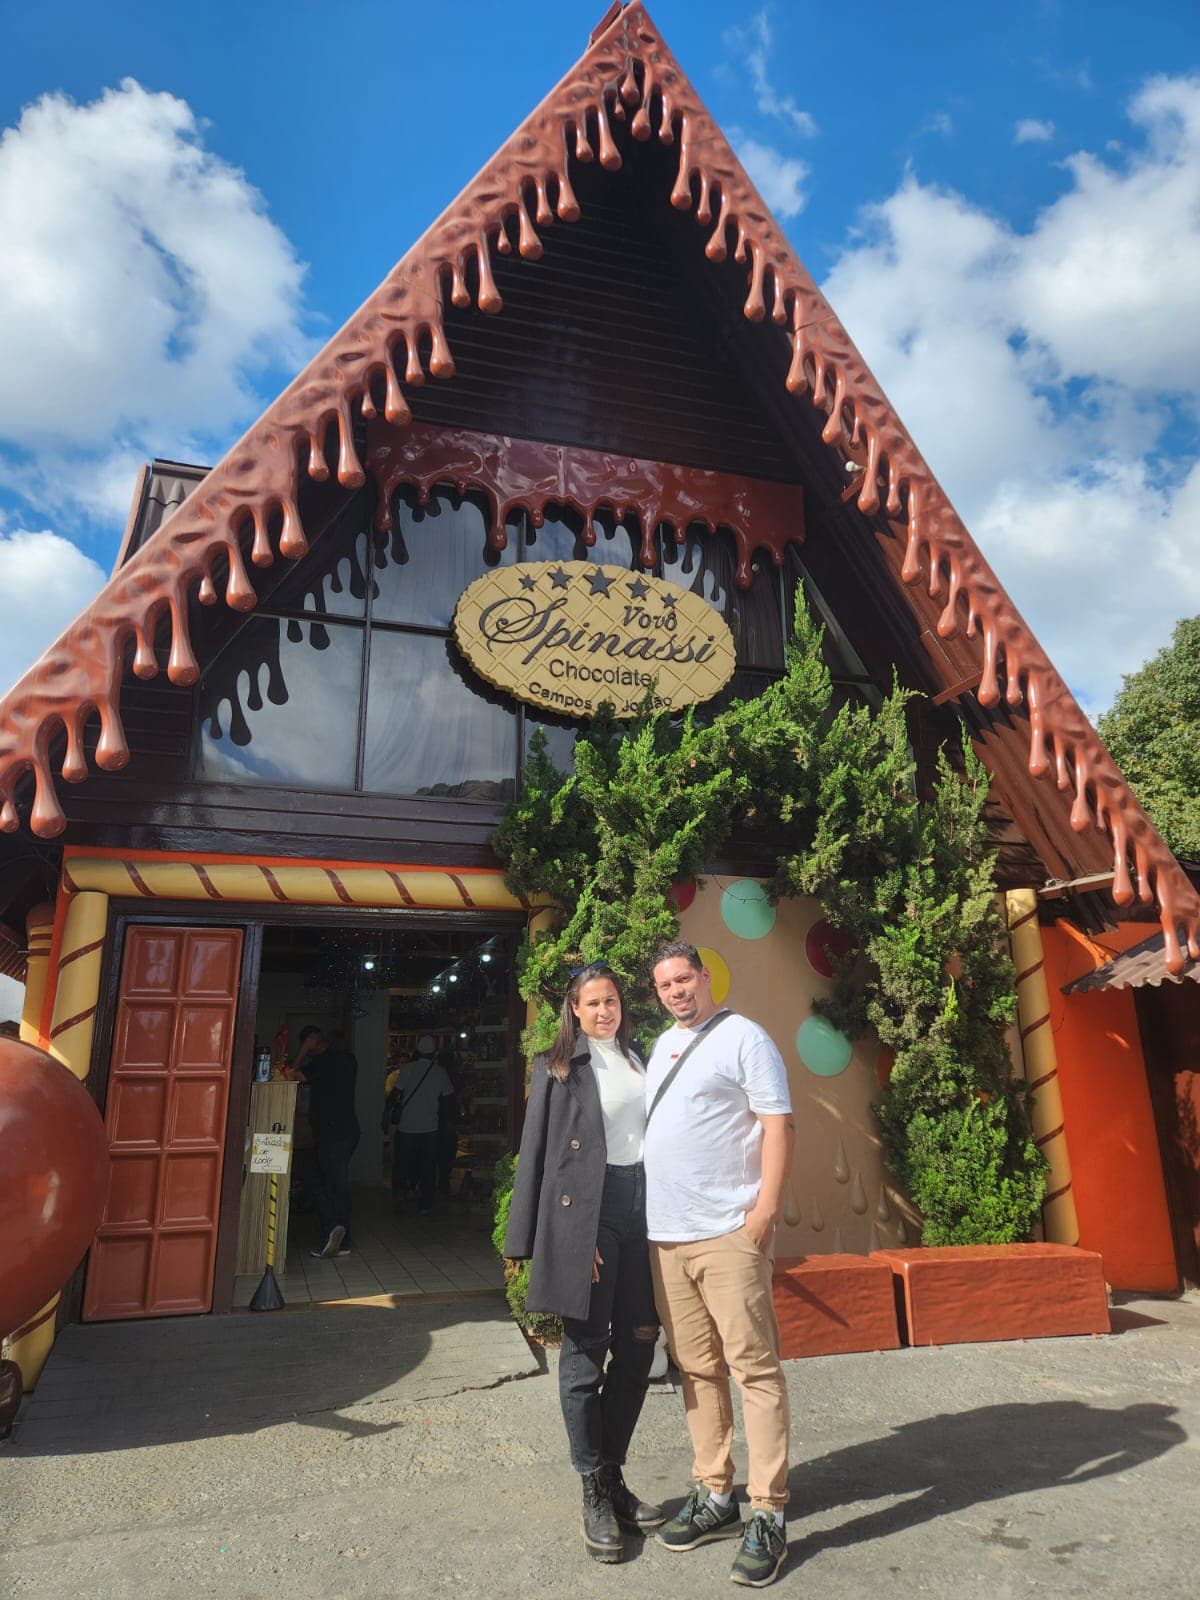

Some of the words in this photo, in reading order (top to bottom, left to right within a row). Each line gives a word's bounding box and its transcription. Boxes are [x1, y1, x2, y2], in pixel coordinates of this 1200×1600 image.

[479, 597, 717, 665] Spinassi
[623, 605, 678, 632] Vovô
[549, 658, 653, 687] Chocolate
[528, 681, 593, 711] Campos
[597, 699, 616, 712] o
[622, 696, 672, 713] João
